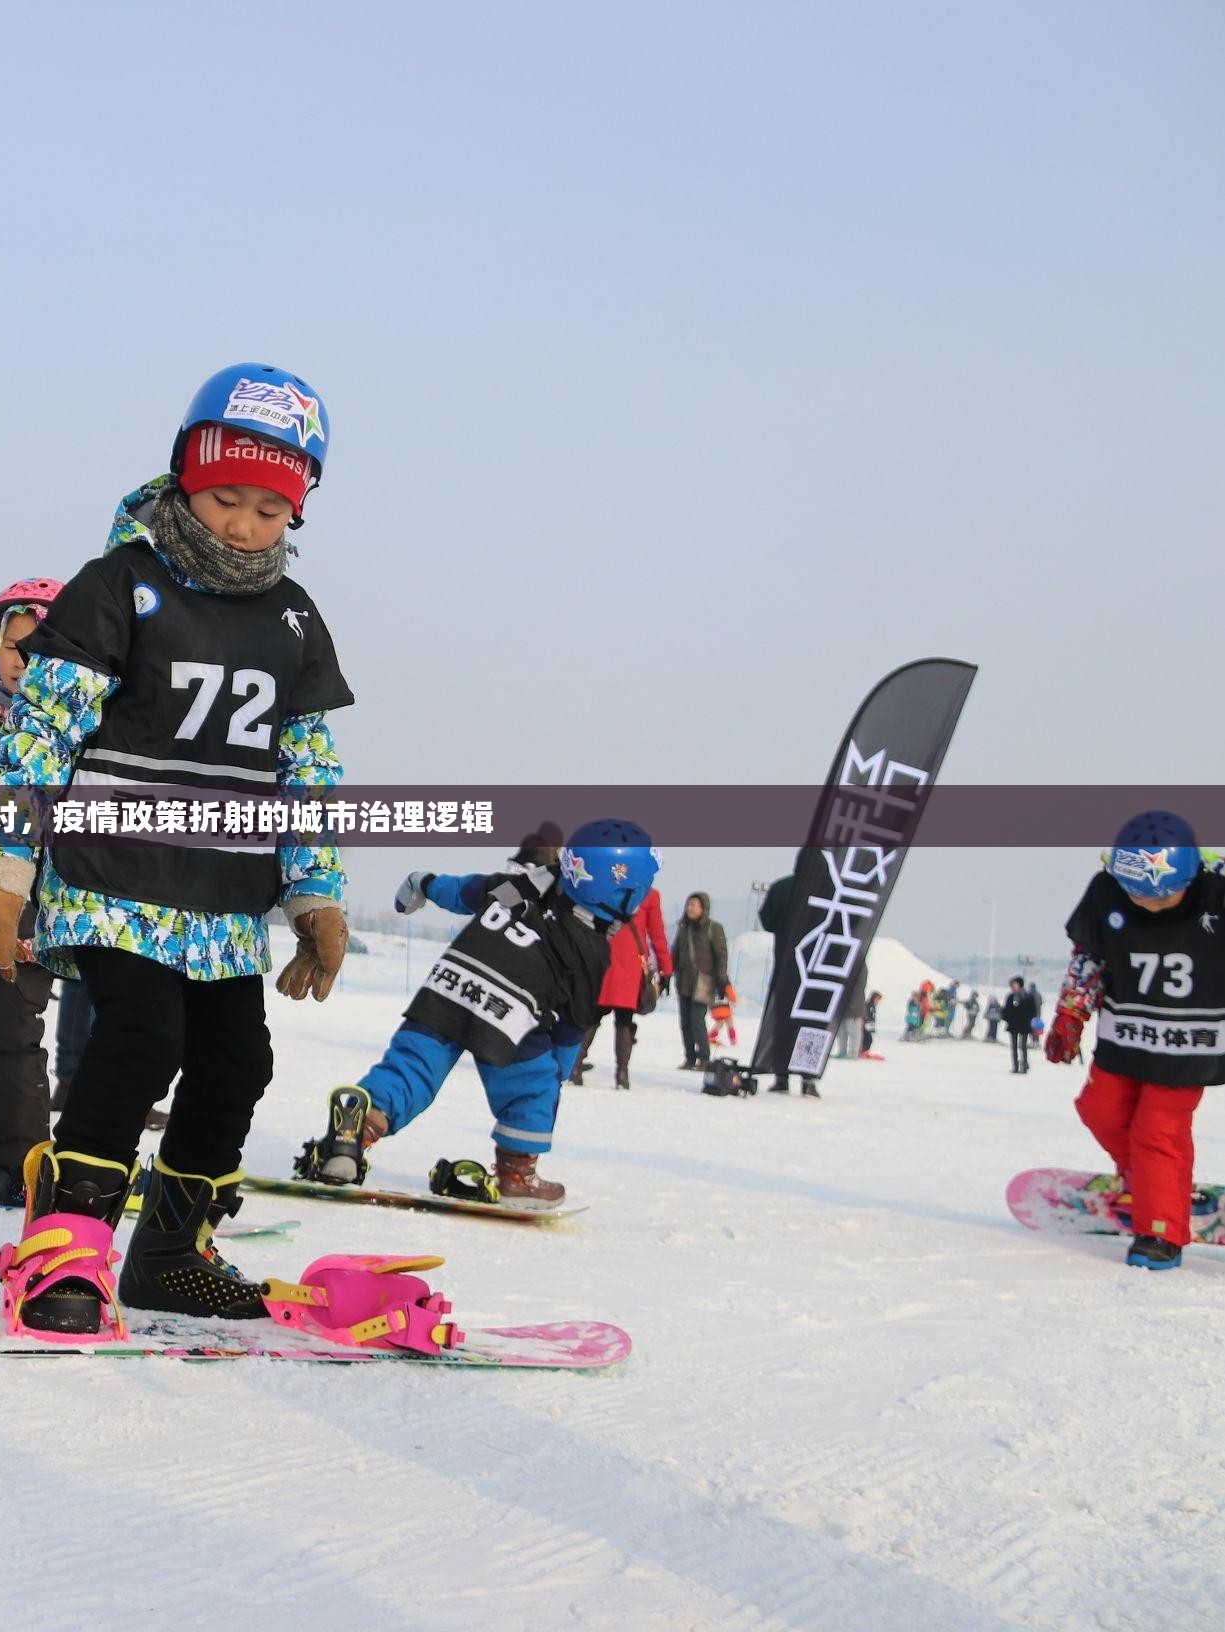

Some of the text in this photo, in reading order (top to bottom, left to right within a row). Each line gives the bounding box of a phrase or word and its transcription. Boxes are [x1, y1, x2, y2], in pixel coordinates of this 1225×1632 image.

[225, 445, 304, 475] adidas
[170, 661, 276, 750] 72
[1129, 952, 1194, 999] 73
[1114, 1021, 1219, 1047] 乔丹体育
